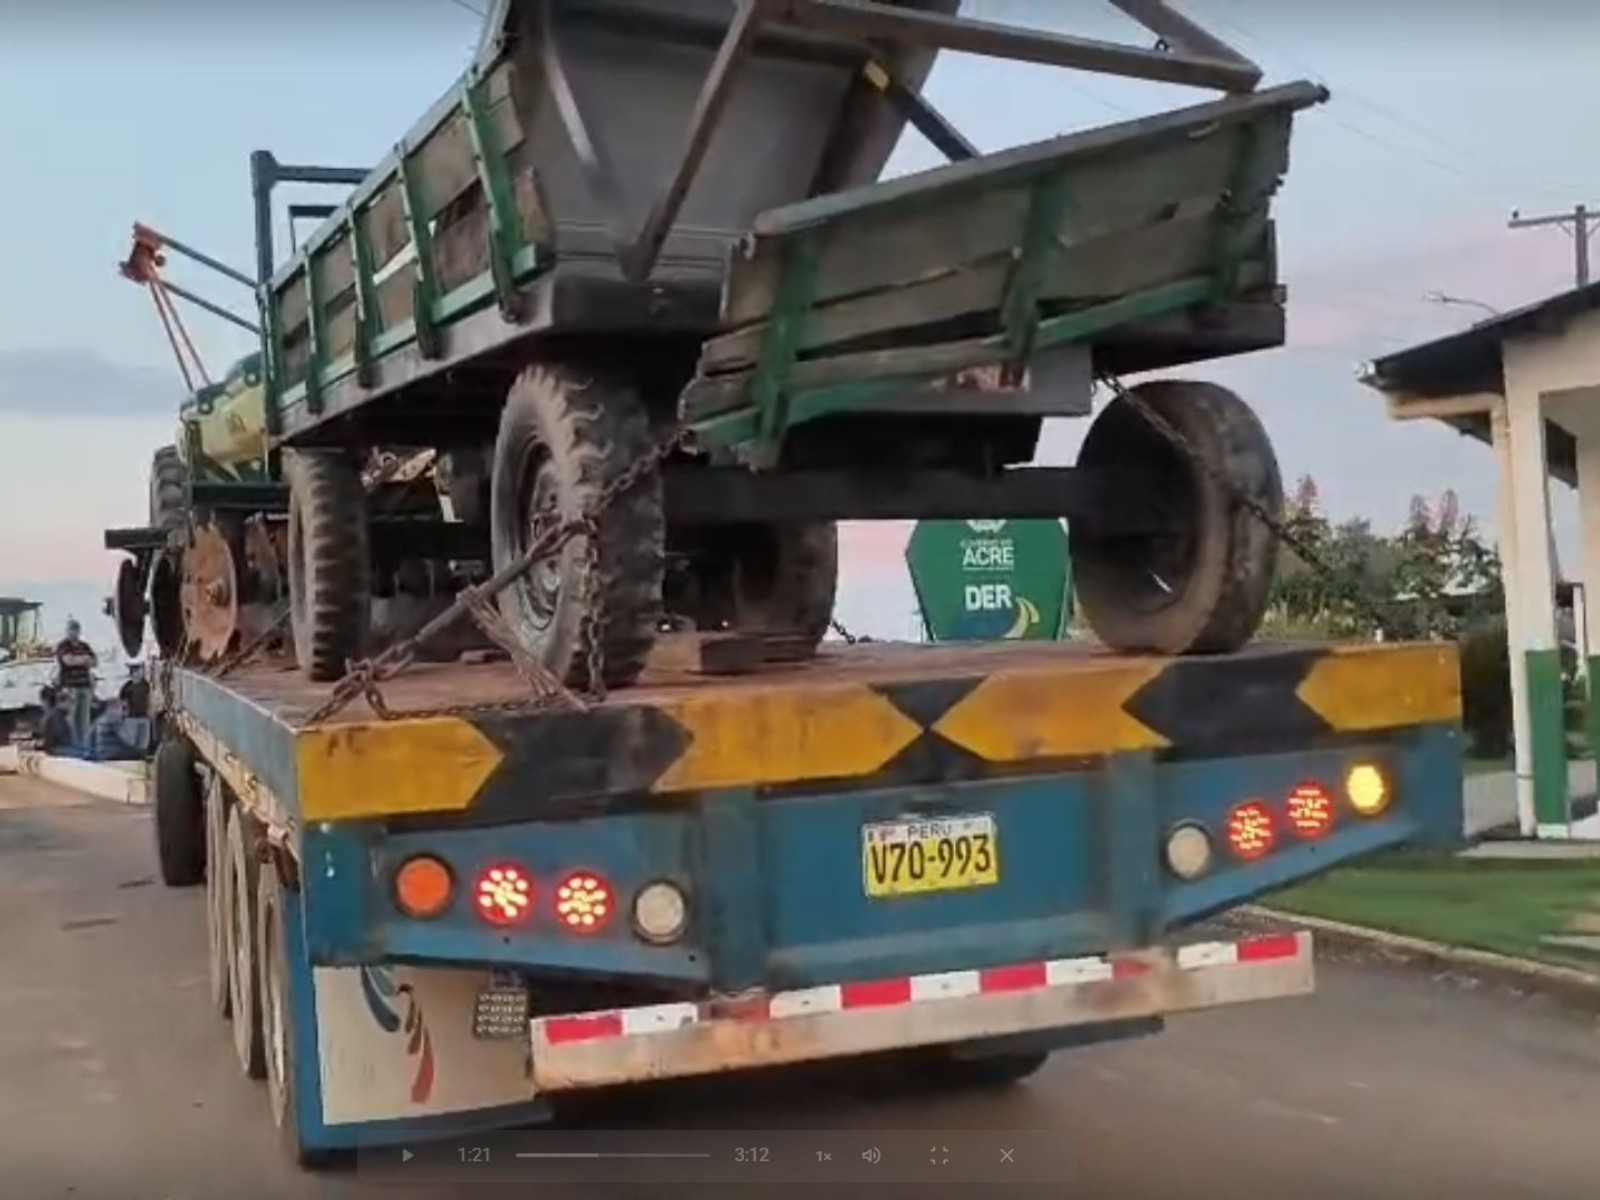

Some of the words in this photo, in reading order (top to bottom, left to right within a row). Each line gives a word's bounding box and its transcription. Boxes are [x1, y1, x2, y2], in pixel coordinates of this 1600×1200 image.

[963, 546, 1014, 566] ACRE
[964, 584, 1012, 611] DER
[907, 823, 951, 840] PERU
[871, 833, 991, 884] V70-993
